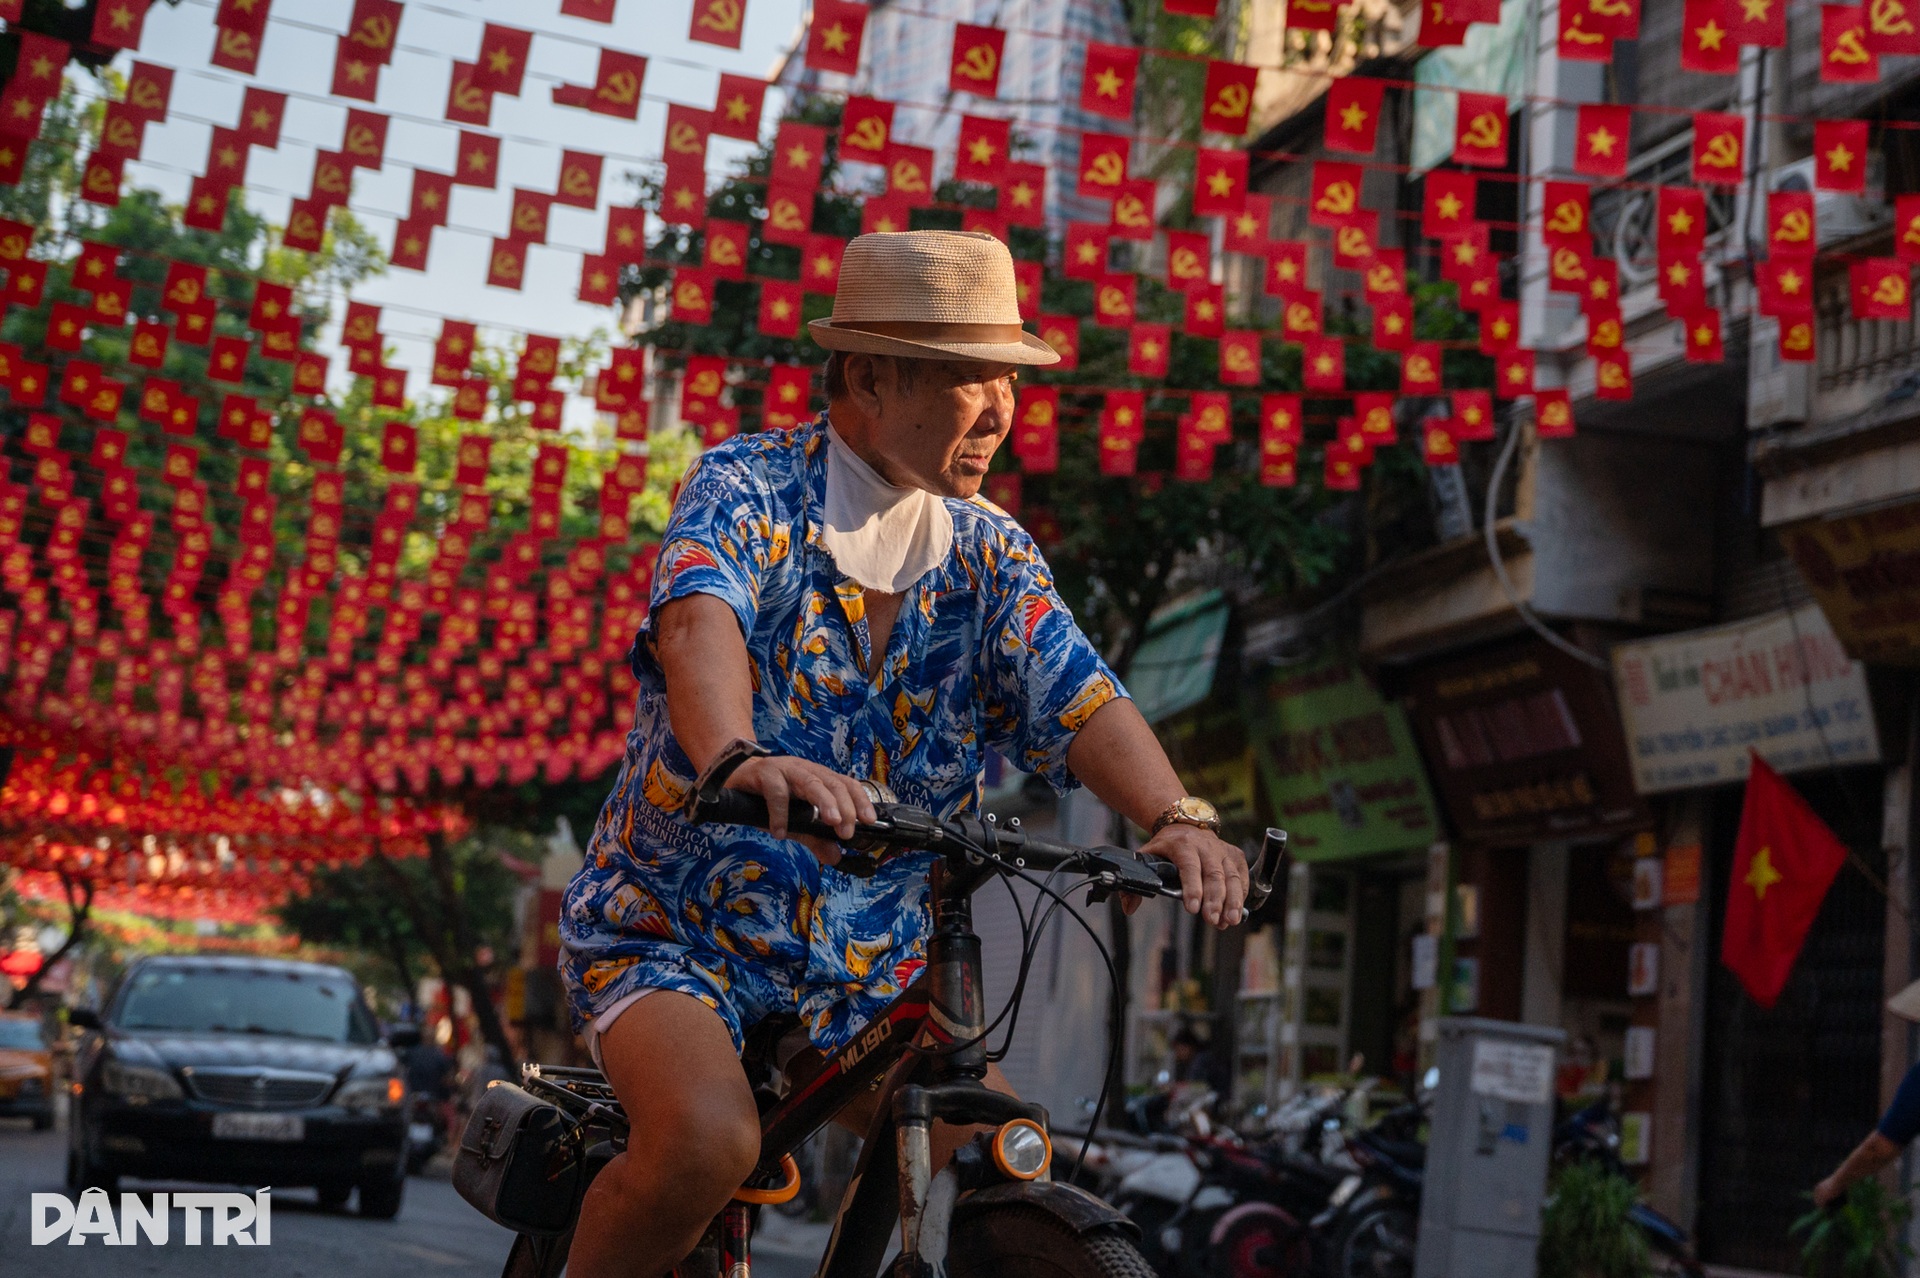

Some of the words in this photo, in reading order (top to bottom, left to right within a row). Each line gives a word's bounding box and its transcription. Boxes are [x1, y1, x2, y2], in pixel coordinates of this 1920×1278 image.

[633, 809, 712, 860] DOMINICANA
[640, 800, 709, 847] REPUBLICA
[838, 1016, 892, 1075] ML190
